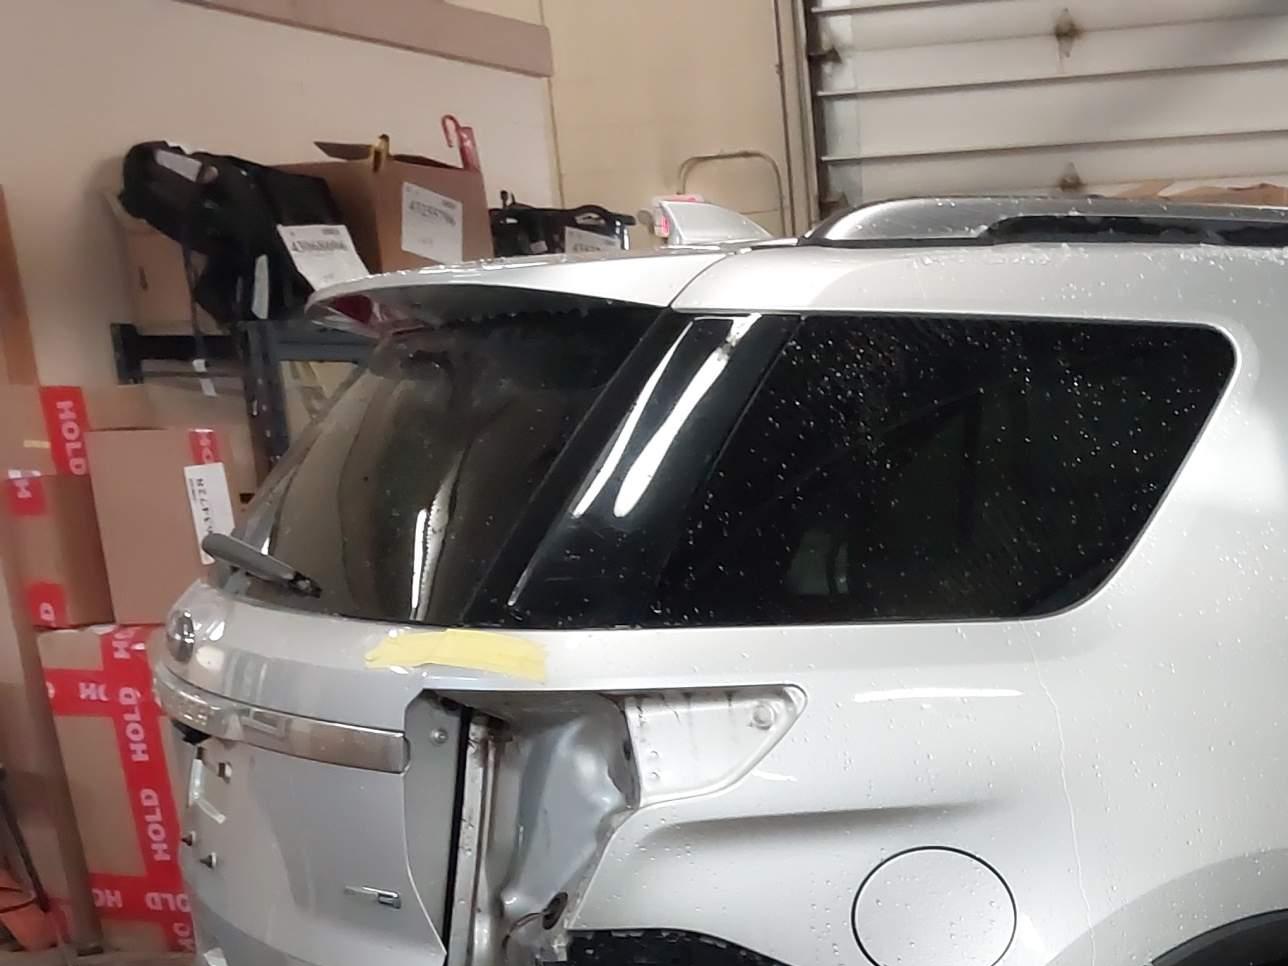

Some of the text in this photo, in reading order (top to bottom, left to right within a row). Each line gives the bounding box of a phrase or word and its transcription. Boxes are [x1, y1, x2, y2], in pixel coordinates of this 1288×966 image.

[56, 400, 87, 476] HOLD
[118, 687, 150, 762] HOLD
[140, 788, 171, 861] HOLD
